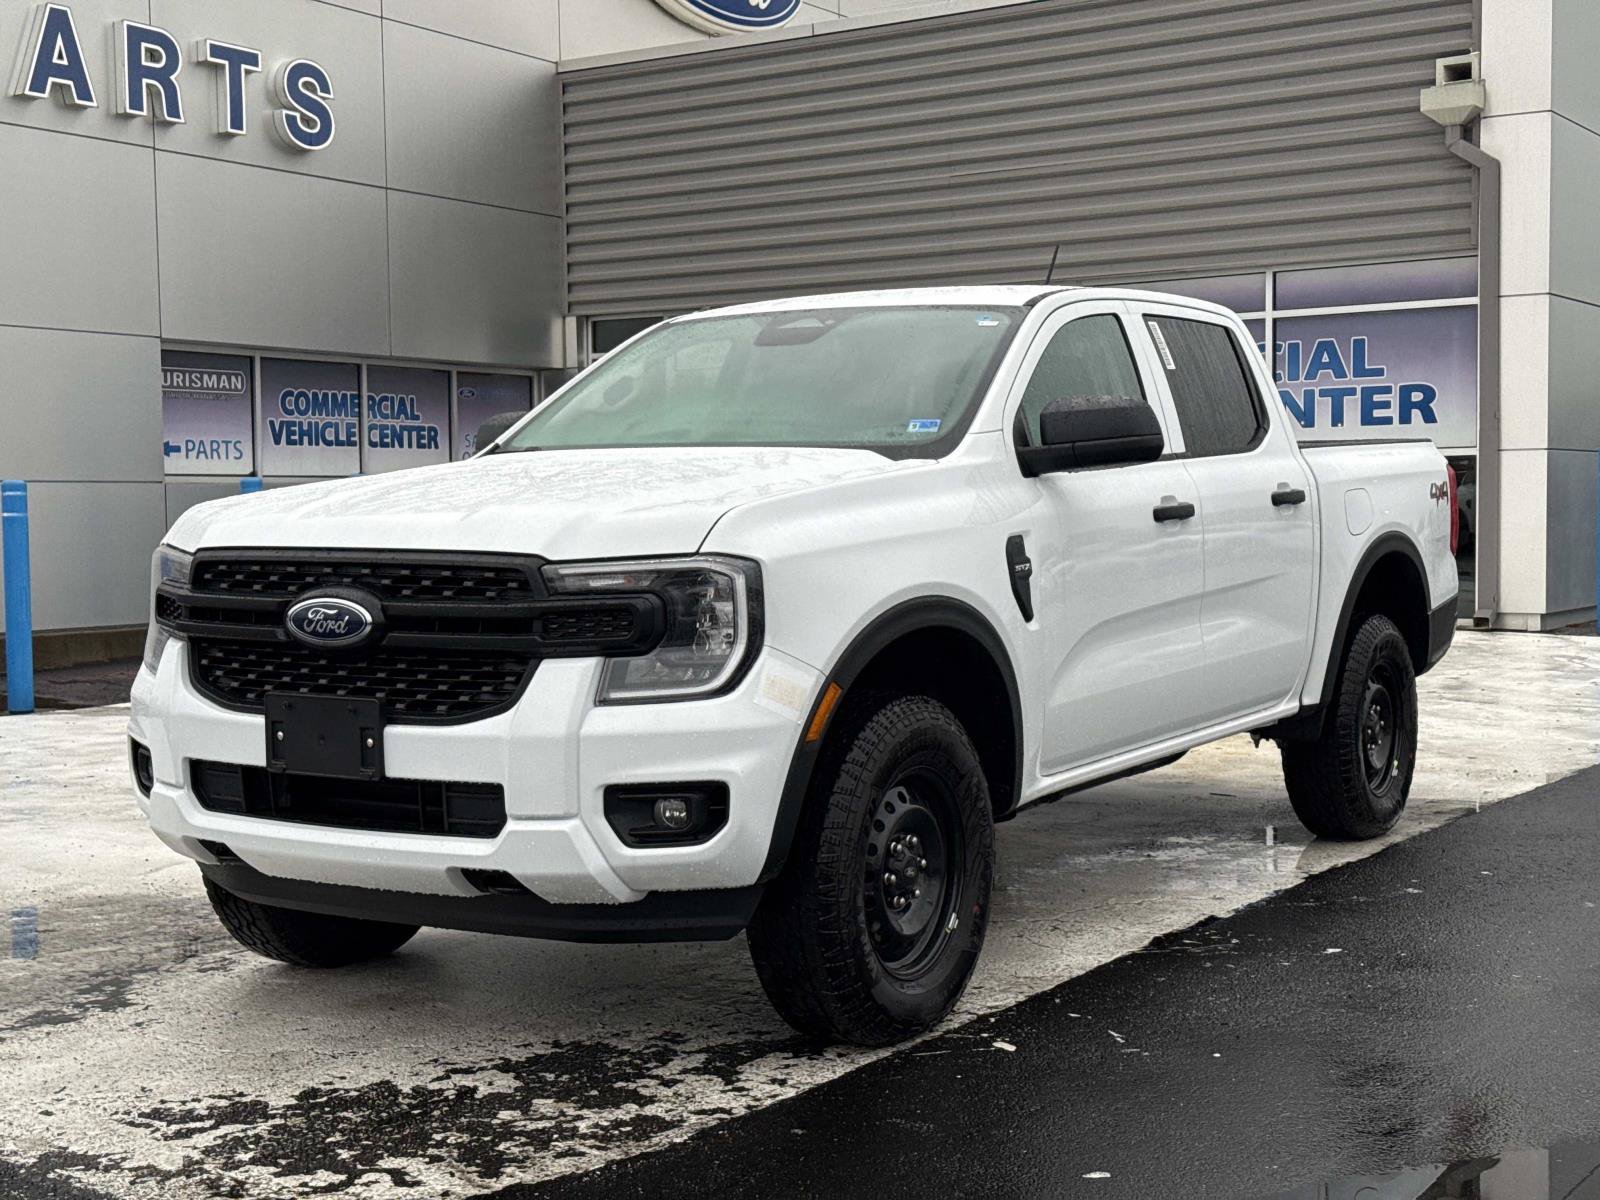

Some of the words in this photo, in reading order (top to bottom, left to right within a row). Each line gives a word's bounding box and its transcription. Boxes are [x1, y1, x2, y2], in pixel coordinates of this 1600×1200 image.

[24, 3, 335, 150] ARTS
[280, 388, 421, 422] COMMERCIAL
[184, 439, 244, 460] PARTS
[268, 419, 358, 448] VEHICLE
[367, 422, 440, 450] CENTER
[303, 607, 350, 633] Ford
